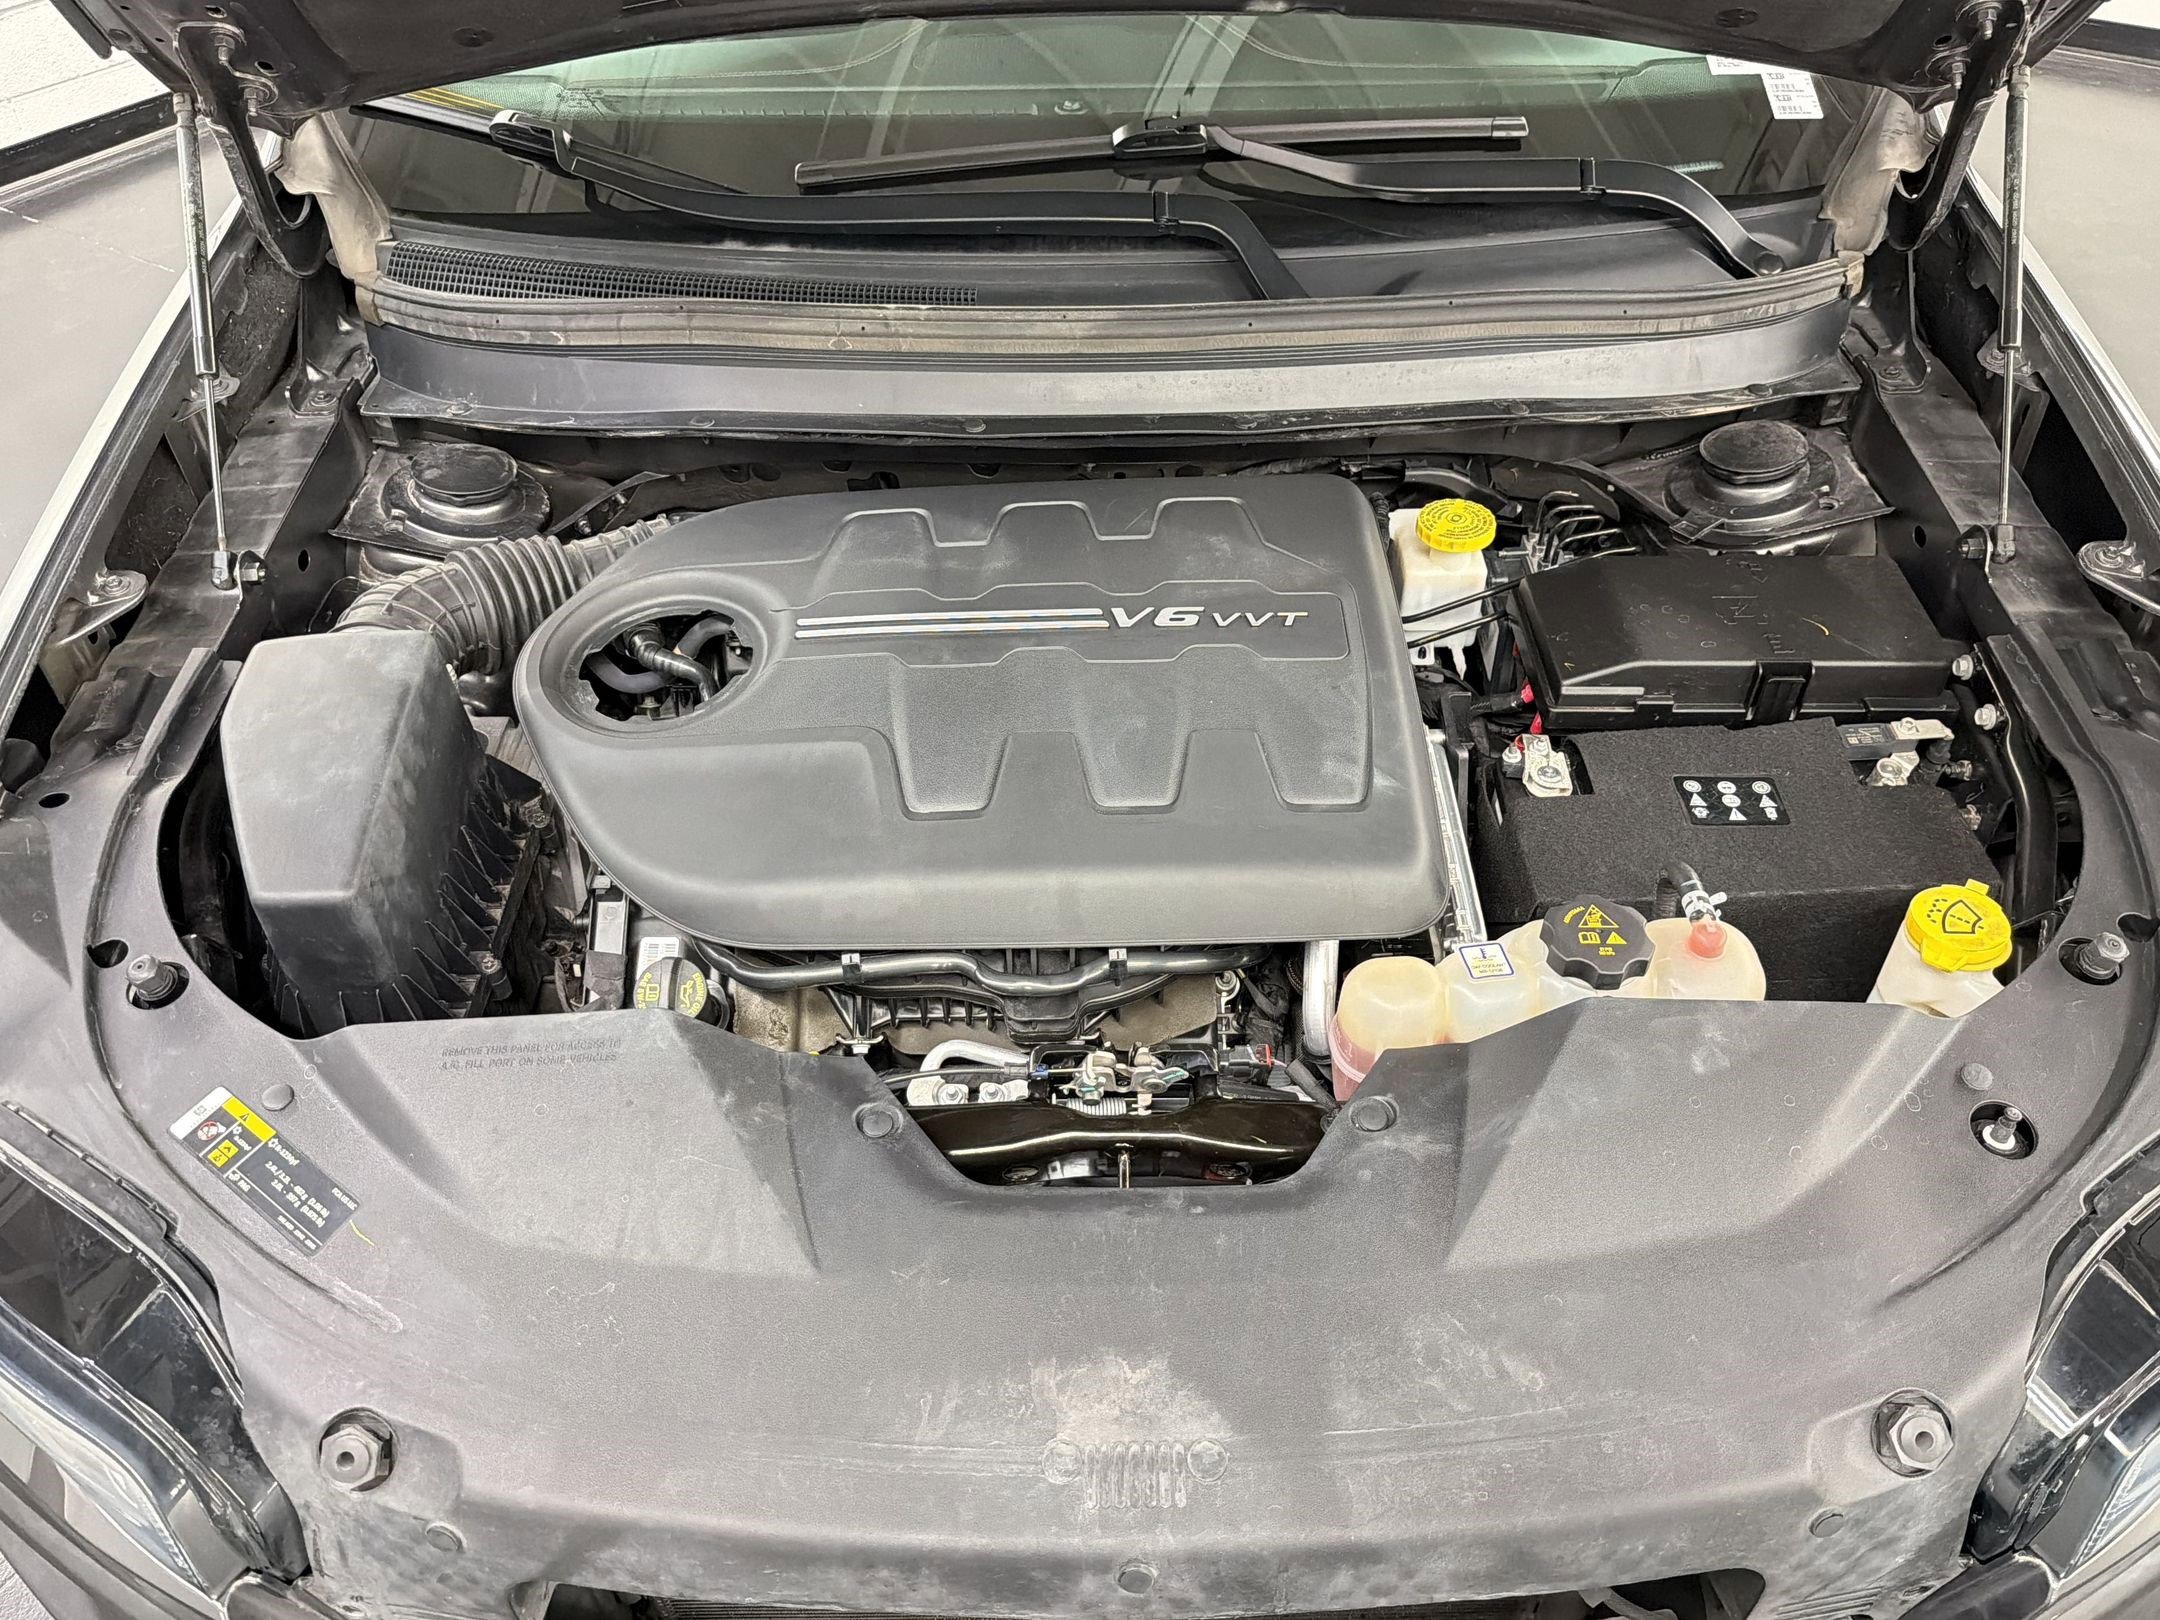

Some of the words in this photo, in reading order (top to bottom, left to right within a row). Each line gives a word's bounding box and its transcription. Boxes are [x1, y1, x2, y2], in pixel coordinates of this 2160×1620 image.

[1110, 606, 1205, 628] V6
[1212, 611, 1309, 628] VVT
[692, 972, 705, 1002] ENGINE
[441, 1046, 483, 1057] REMOVE
[485, 1045, 508, 1055] THIS
[510, 1043, 541, 1054] PANEL
[544, 1041, 565, 1052] FOR
[567, 1039, 606, 1050] ACCESS
[465, 1059, 484, 1069] FILL
[489, 1058, 515, 1068] PORT
[518, 1056, 534, 1066] ON
[537, 1054, 566, 1065] SOME
[568, 1052, 617, 1063] VEHICLES
[274, 1144, 300, 1166] R-1234yf
[237, 1180, 251, 1192] PAG
